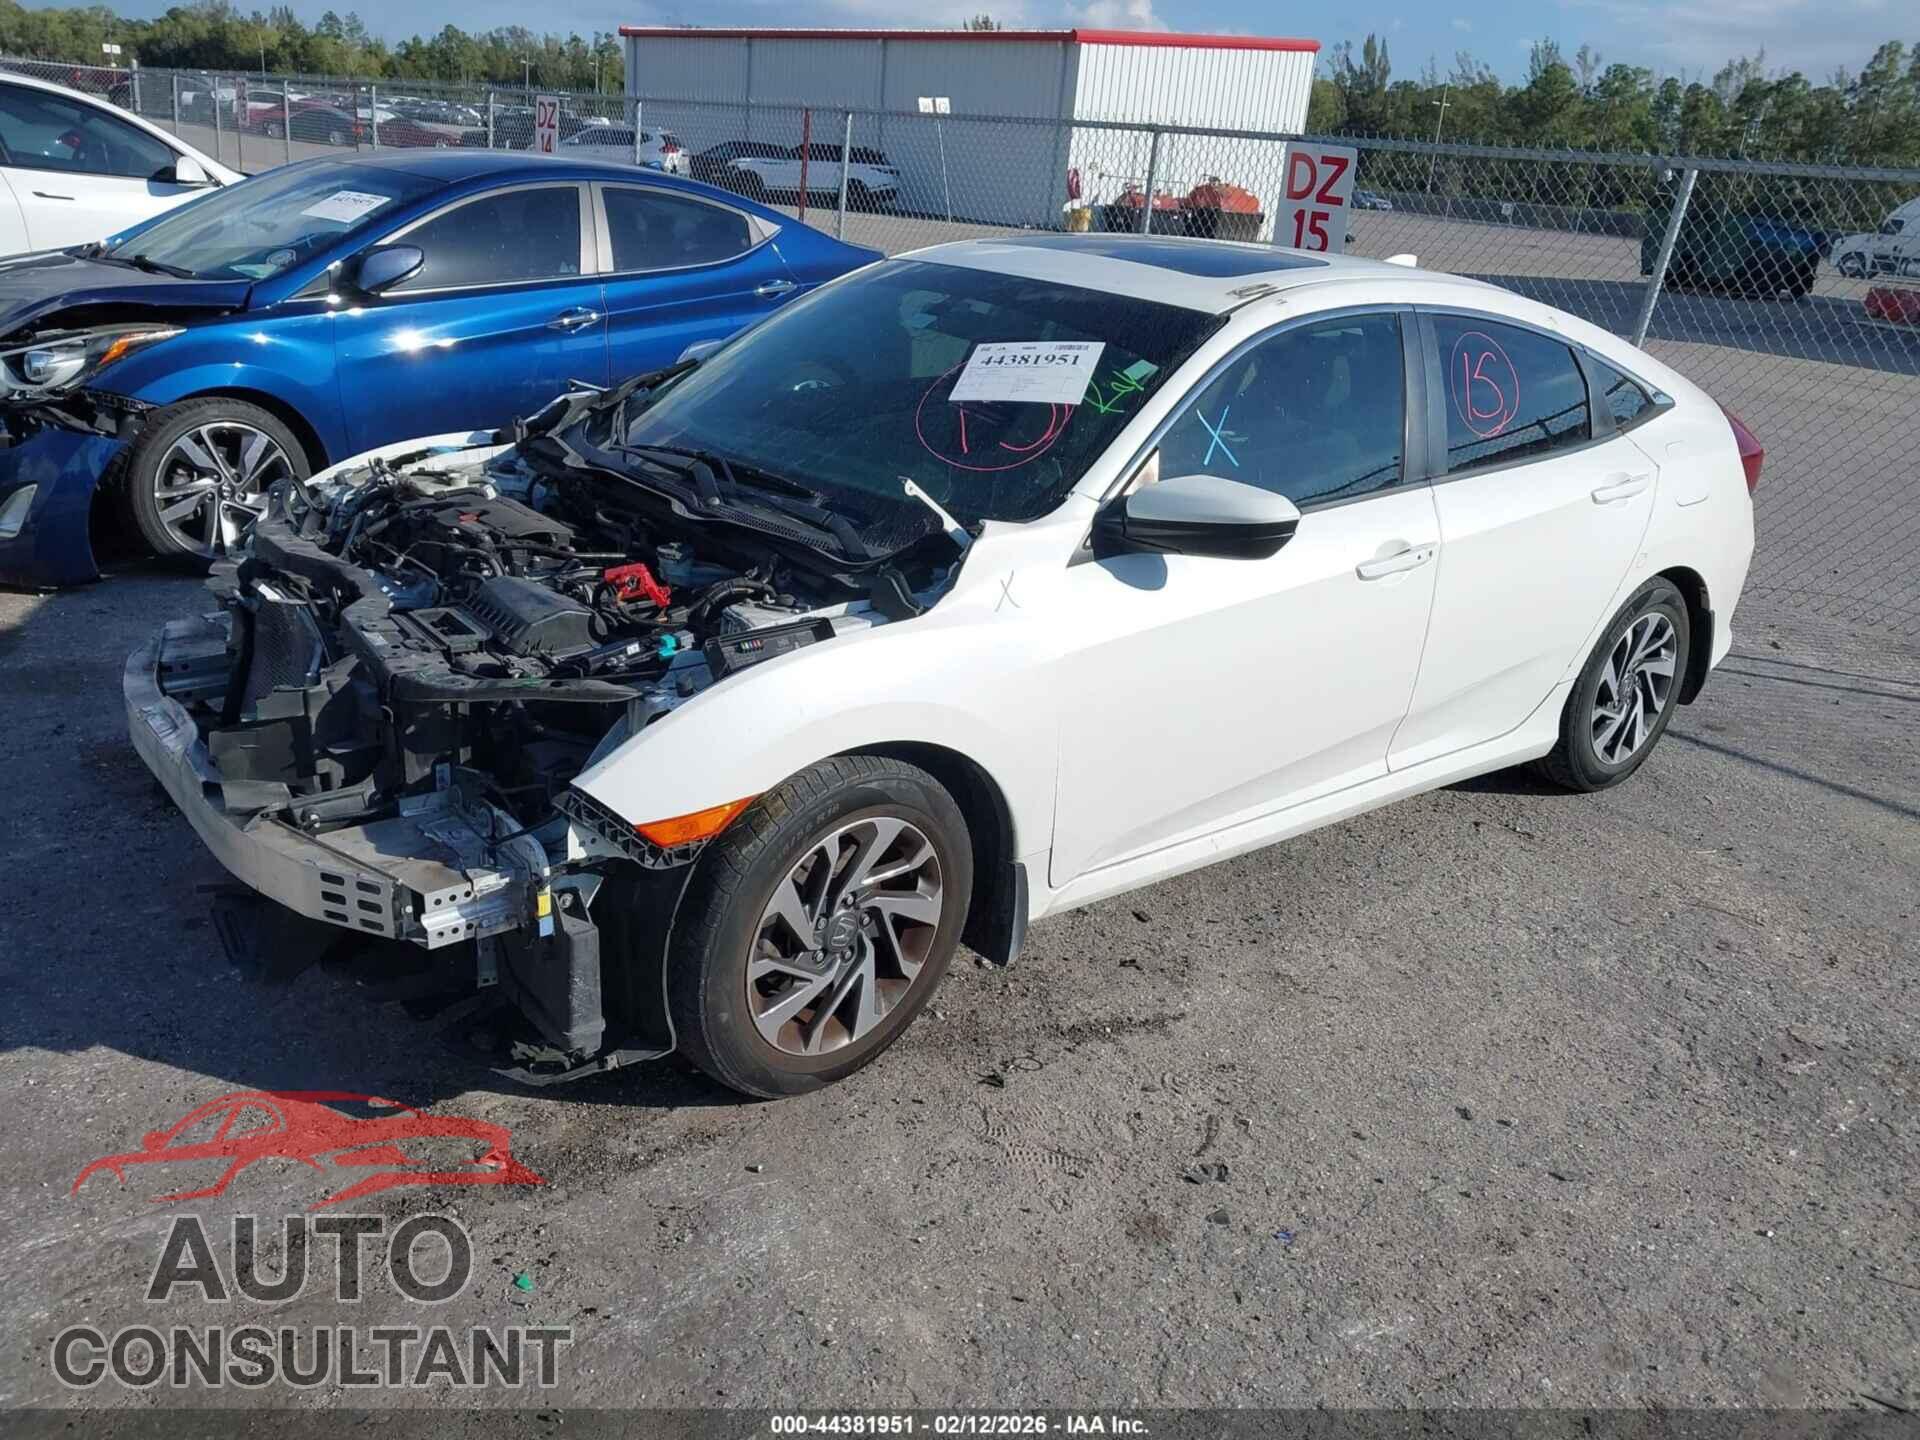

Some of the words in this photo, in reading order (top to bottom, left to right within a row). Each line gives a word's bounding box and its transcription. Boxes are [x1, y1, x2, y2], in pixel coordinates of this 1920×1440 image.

[538, 101, 557, 129] DZ
[1286, 152, 1349, 206] DZ
[1294, 208, 1330, 252] 15
[981, 354, 1080, 366] 44381951
